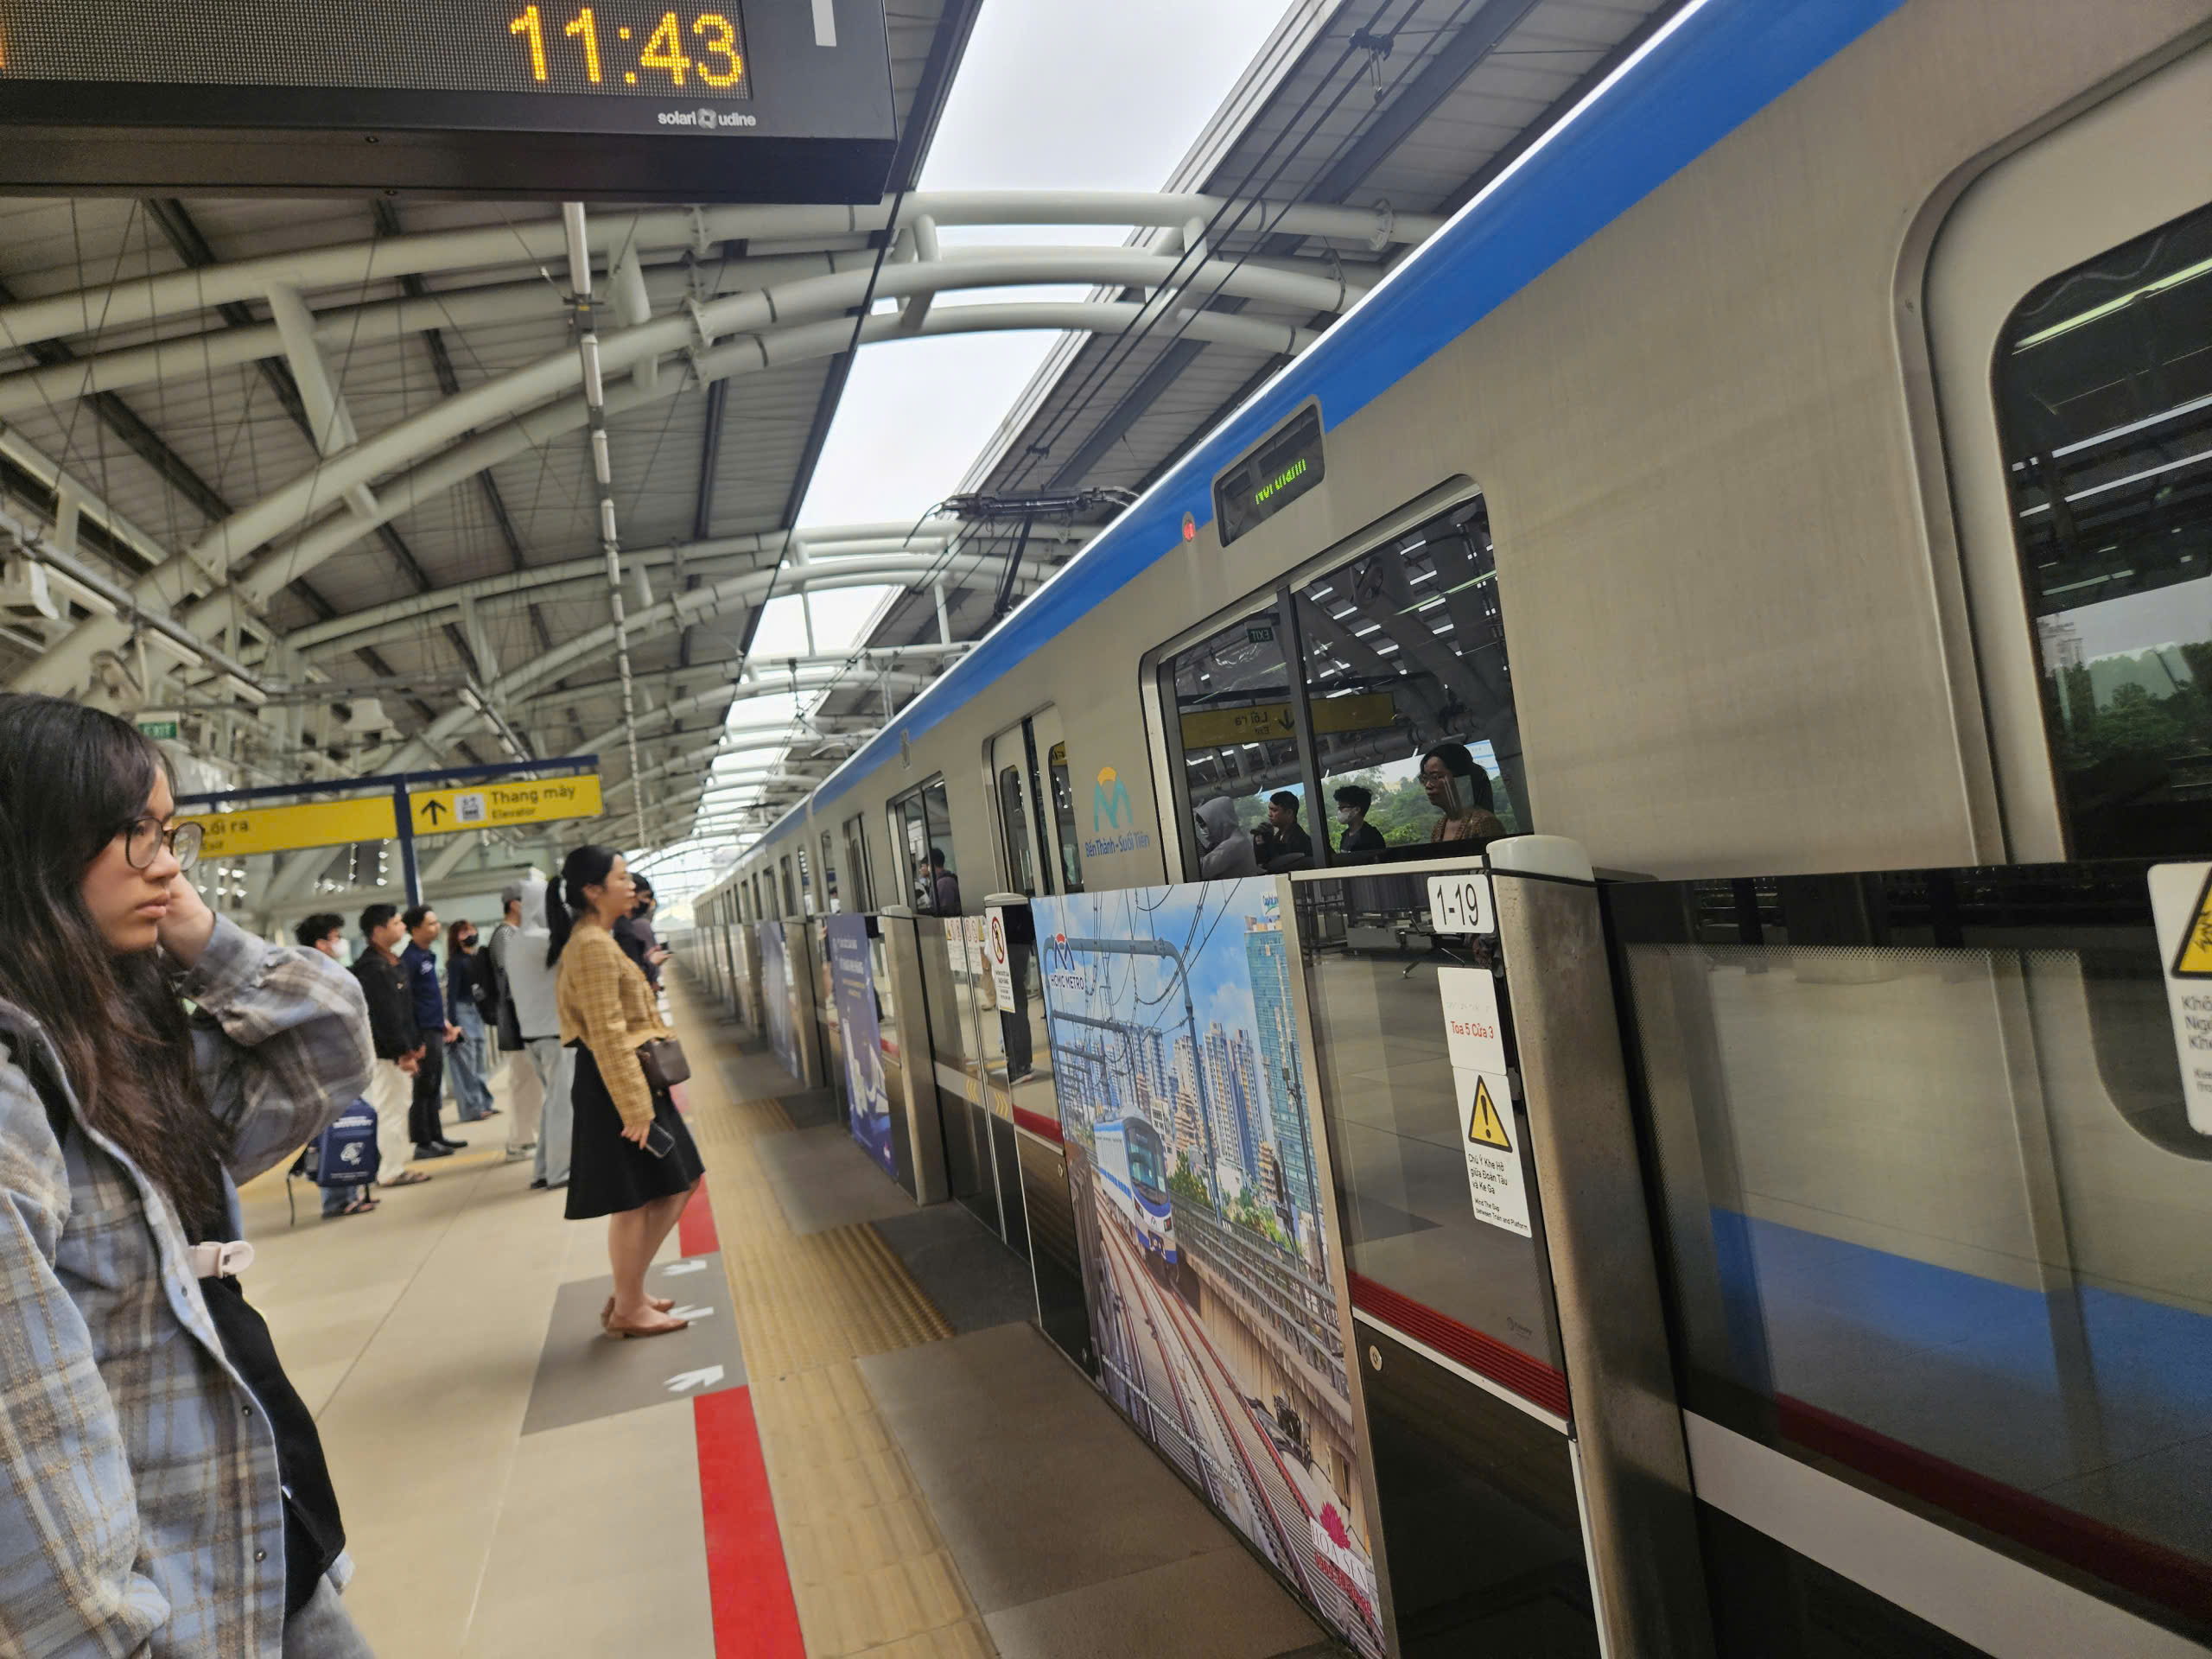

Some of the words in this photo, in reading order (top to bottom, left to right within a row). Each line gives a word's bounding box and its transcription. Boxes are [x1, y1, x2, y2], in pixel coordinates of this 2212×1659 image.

[510, 5, 743, 87] 11:43
[658, 111, 696, 125] solari
[718, 111, 757, 127] udine
[491, 789, 539, 805] Thang
[543, 784, 576, 802] máy
[230, 822, 249, 833] ra
[1437, 883, 1478, 927] 1-19
[1051, 974, 1065, 988] HCMC
[1065, 976, 1084, 990] METRO
[1450, 1020, 1465, 1035] Toa
[1465, 1022, 1471, 1036] 5
[1471, 1022, 1488, 1039] Cửa
[1488, 1025, 1494, 1039] 3
[1311, 1522, 1340, 1565] HOA
[1343, 1550, 1368, 1591] SEN
